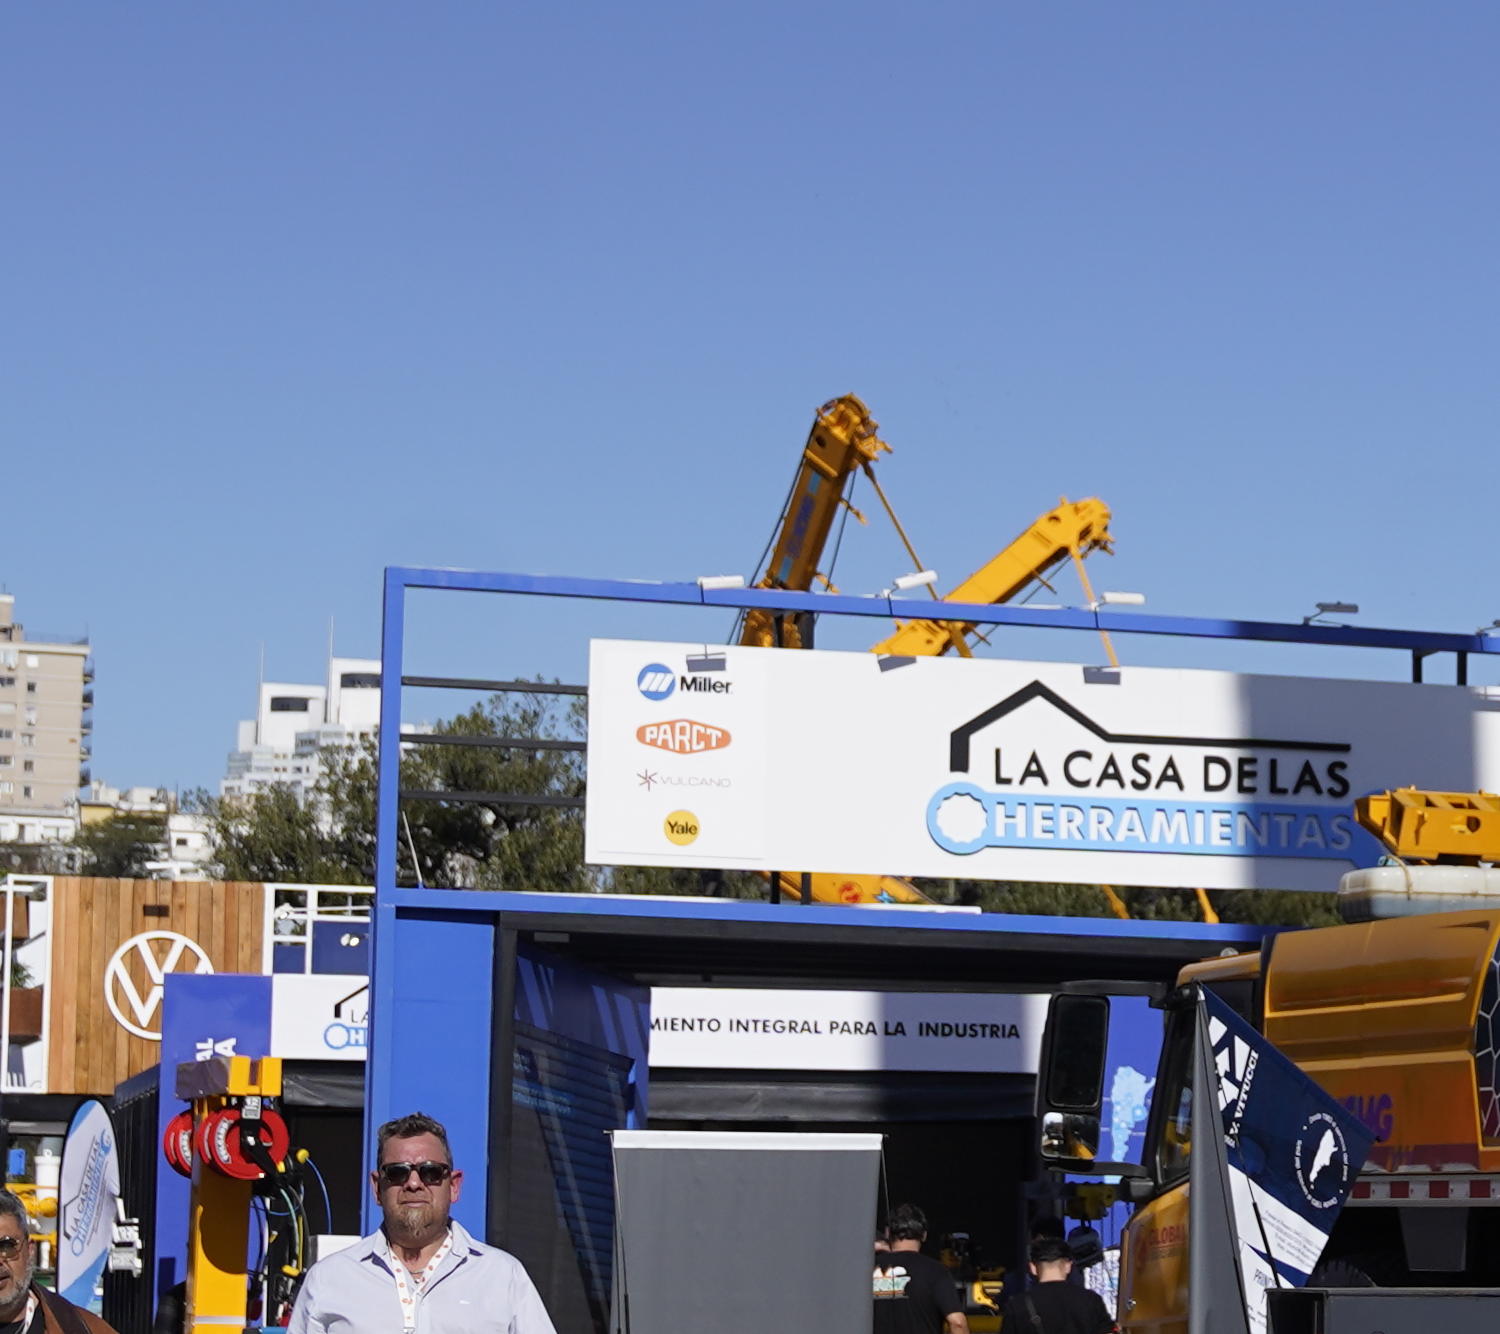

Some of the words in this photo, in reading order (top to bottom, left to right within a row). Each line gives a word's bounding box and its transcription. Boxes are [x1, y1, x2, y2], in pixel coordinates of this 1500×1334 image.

[661, 776, 731, 788] VULCANO
[994, 747, 1047, 787] LA
[1063, 749, 1186, 792] CASA
[667, 819, 698, 836] Yale
[994, 800, 1353, 851] HERRAMIENTAS
[648, 1016, 721, 1033] MIENTO
[728, 1018, 822, 1035] INTEGRAL
[829, 1019, 878, 1036] PARA
[884, 1020, 907, 1037] LA
[918, 1021, 1020, 1039] INDUSTRIA
[1235, 1050, 1259, 1118] VITUCCI
